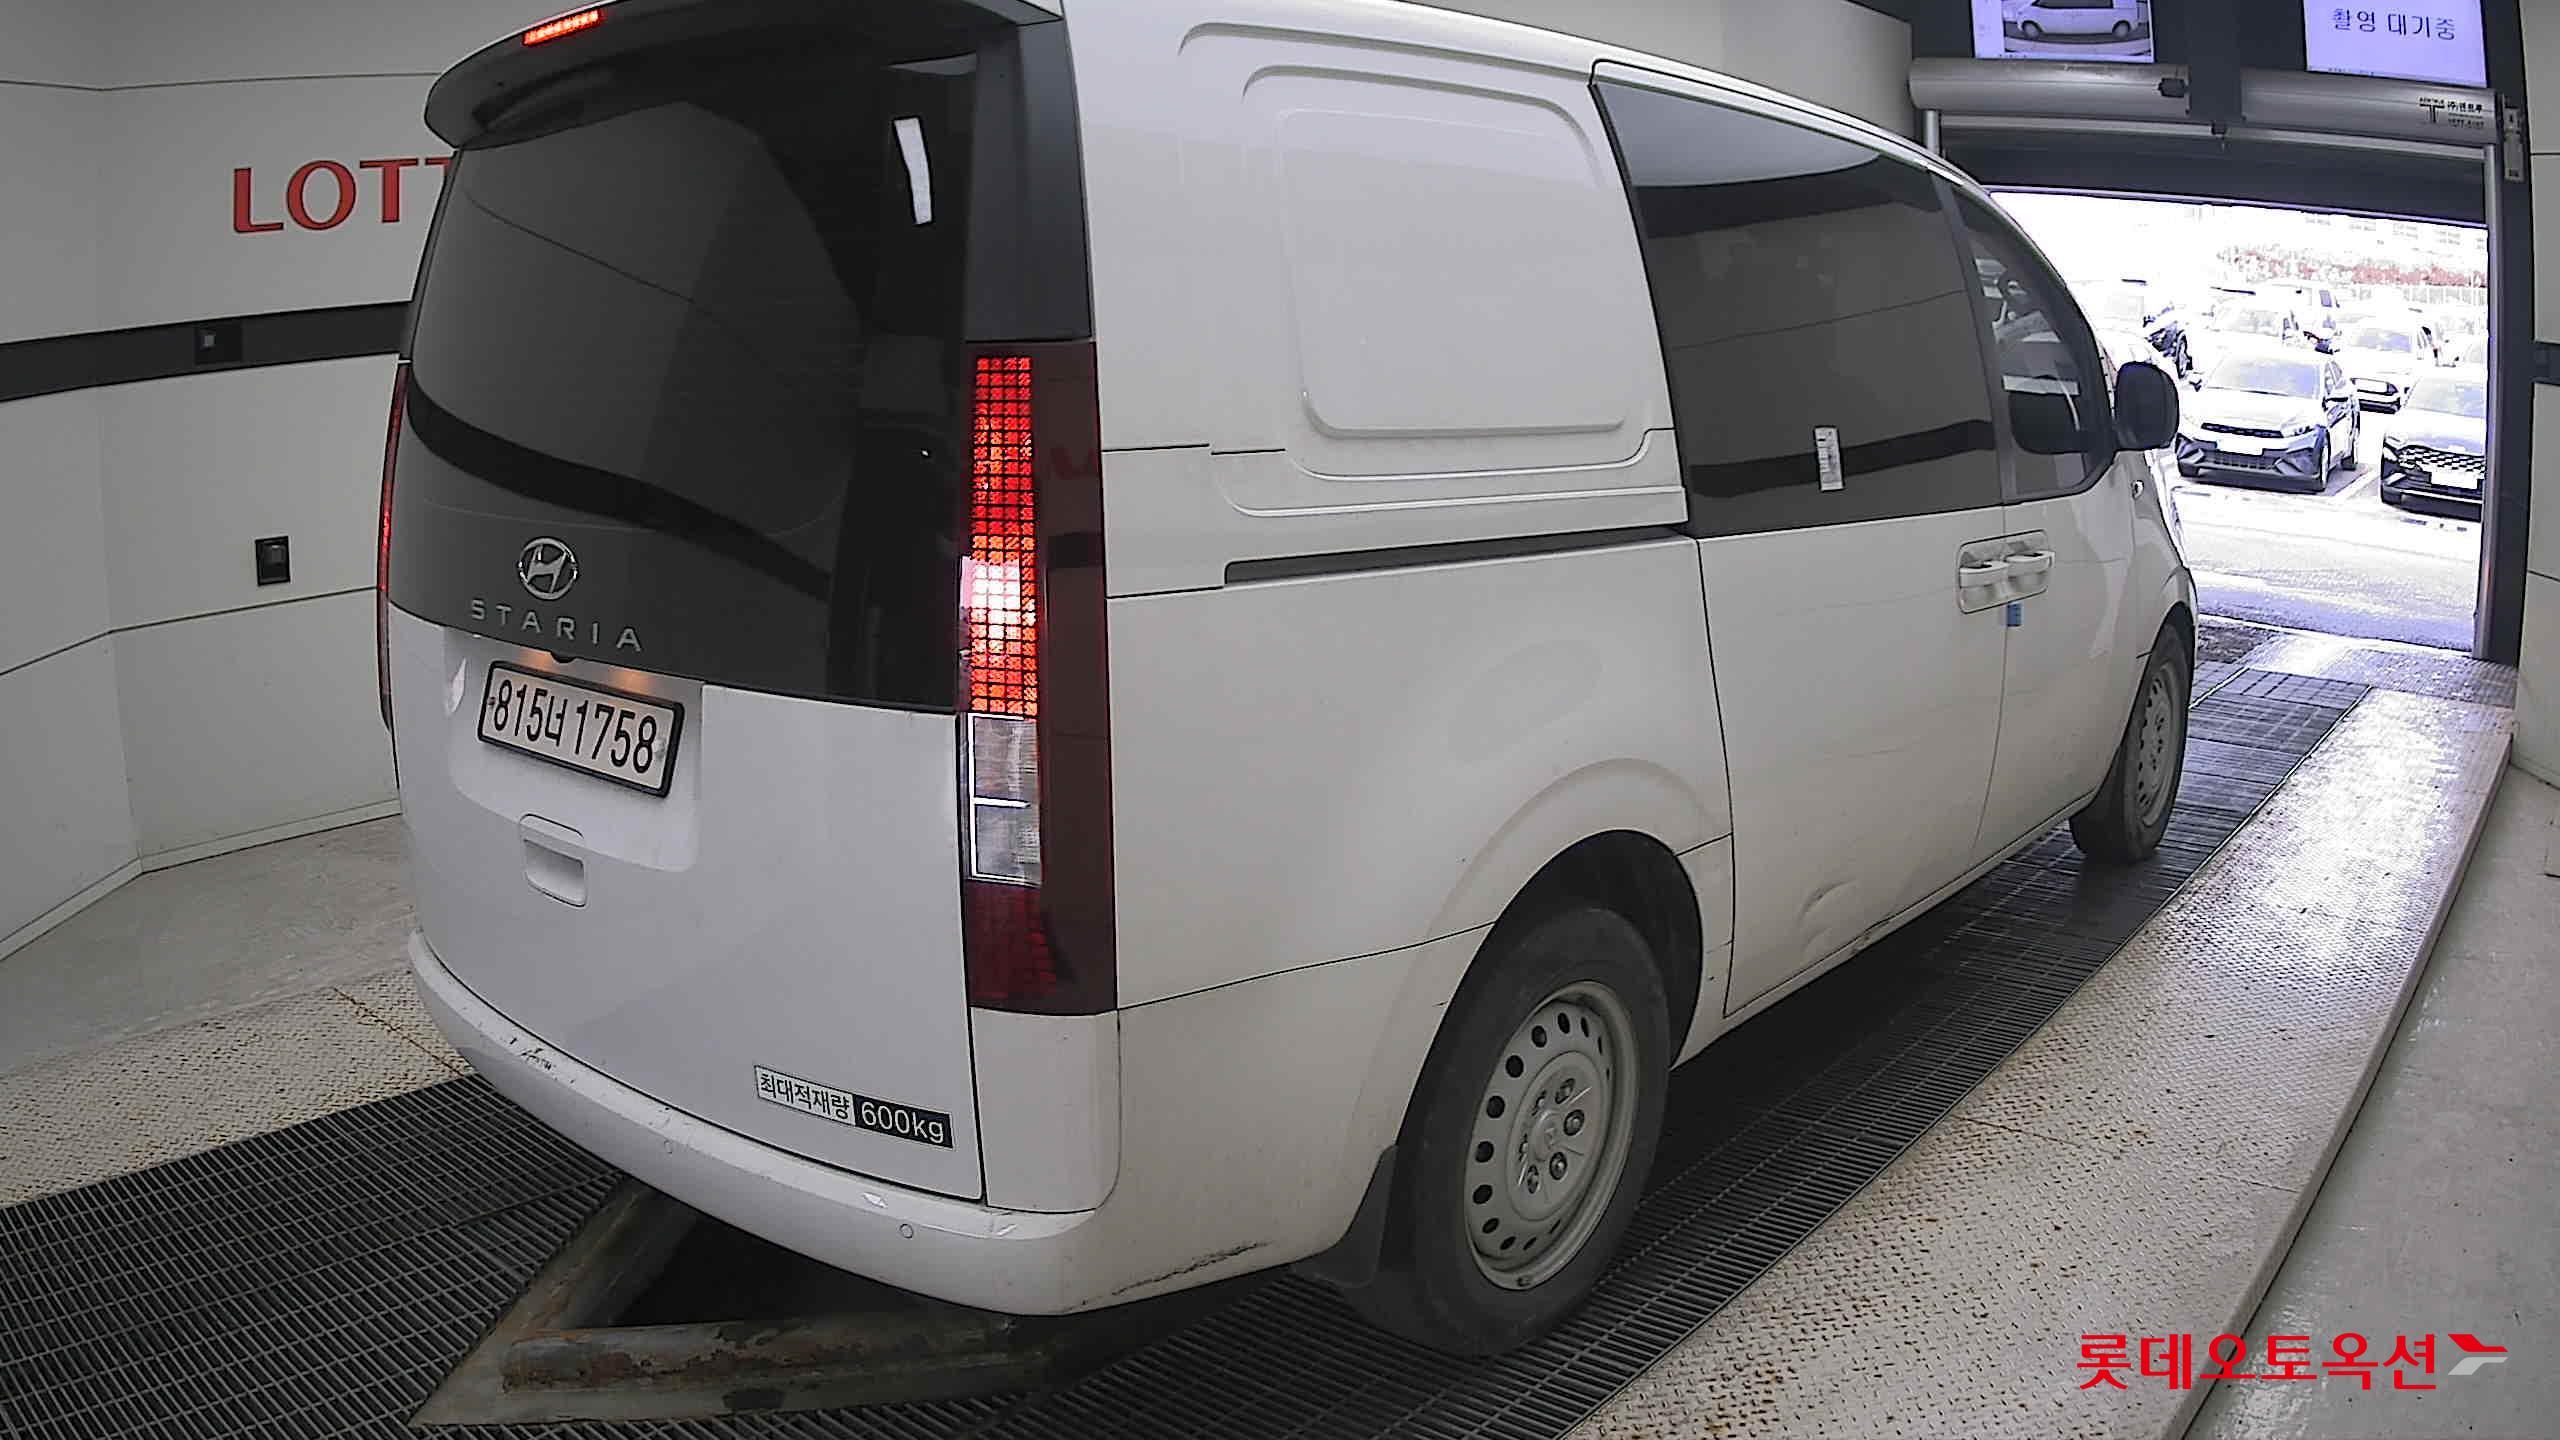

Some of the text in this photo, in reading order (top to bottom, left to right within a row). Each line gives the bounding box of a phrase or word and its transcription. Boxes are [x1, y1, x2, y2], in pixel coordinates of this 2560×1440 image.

[2334, 8, 2456, 41] 촬영 대기중
[233, 157, 453, 234] LOT
[471, 599, 642, 652] STARIA
[760, 1072, 944, 1144] 최대적재량 600kg
